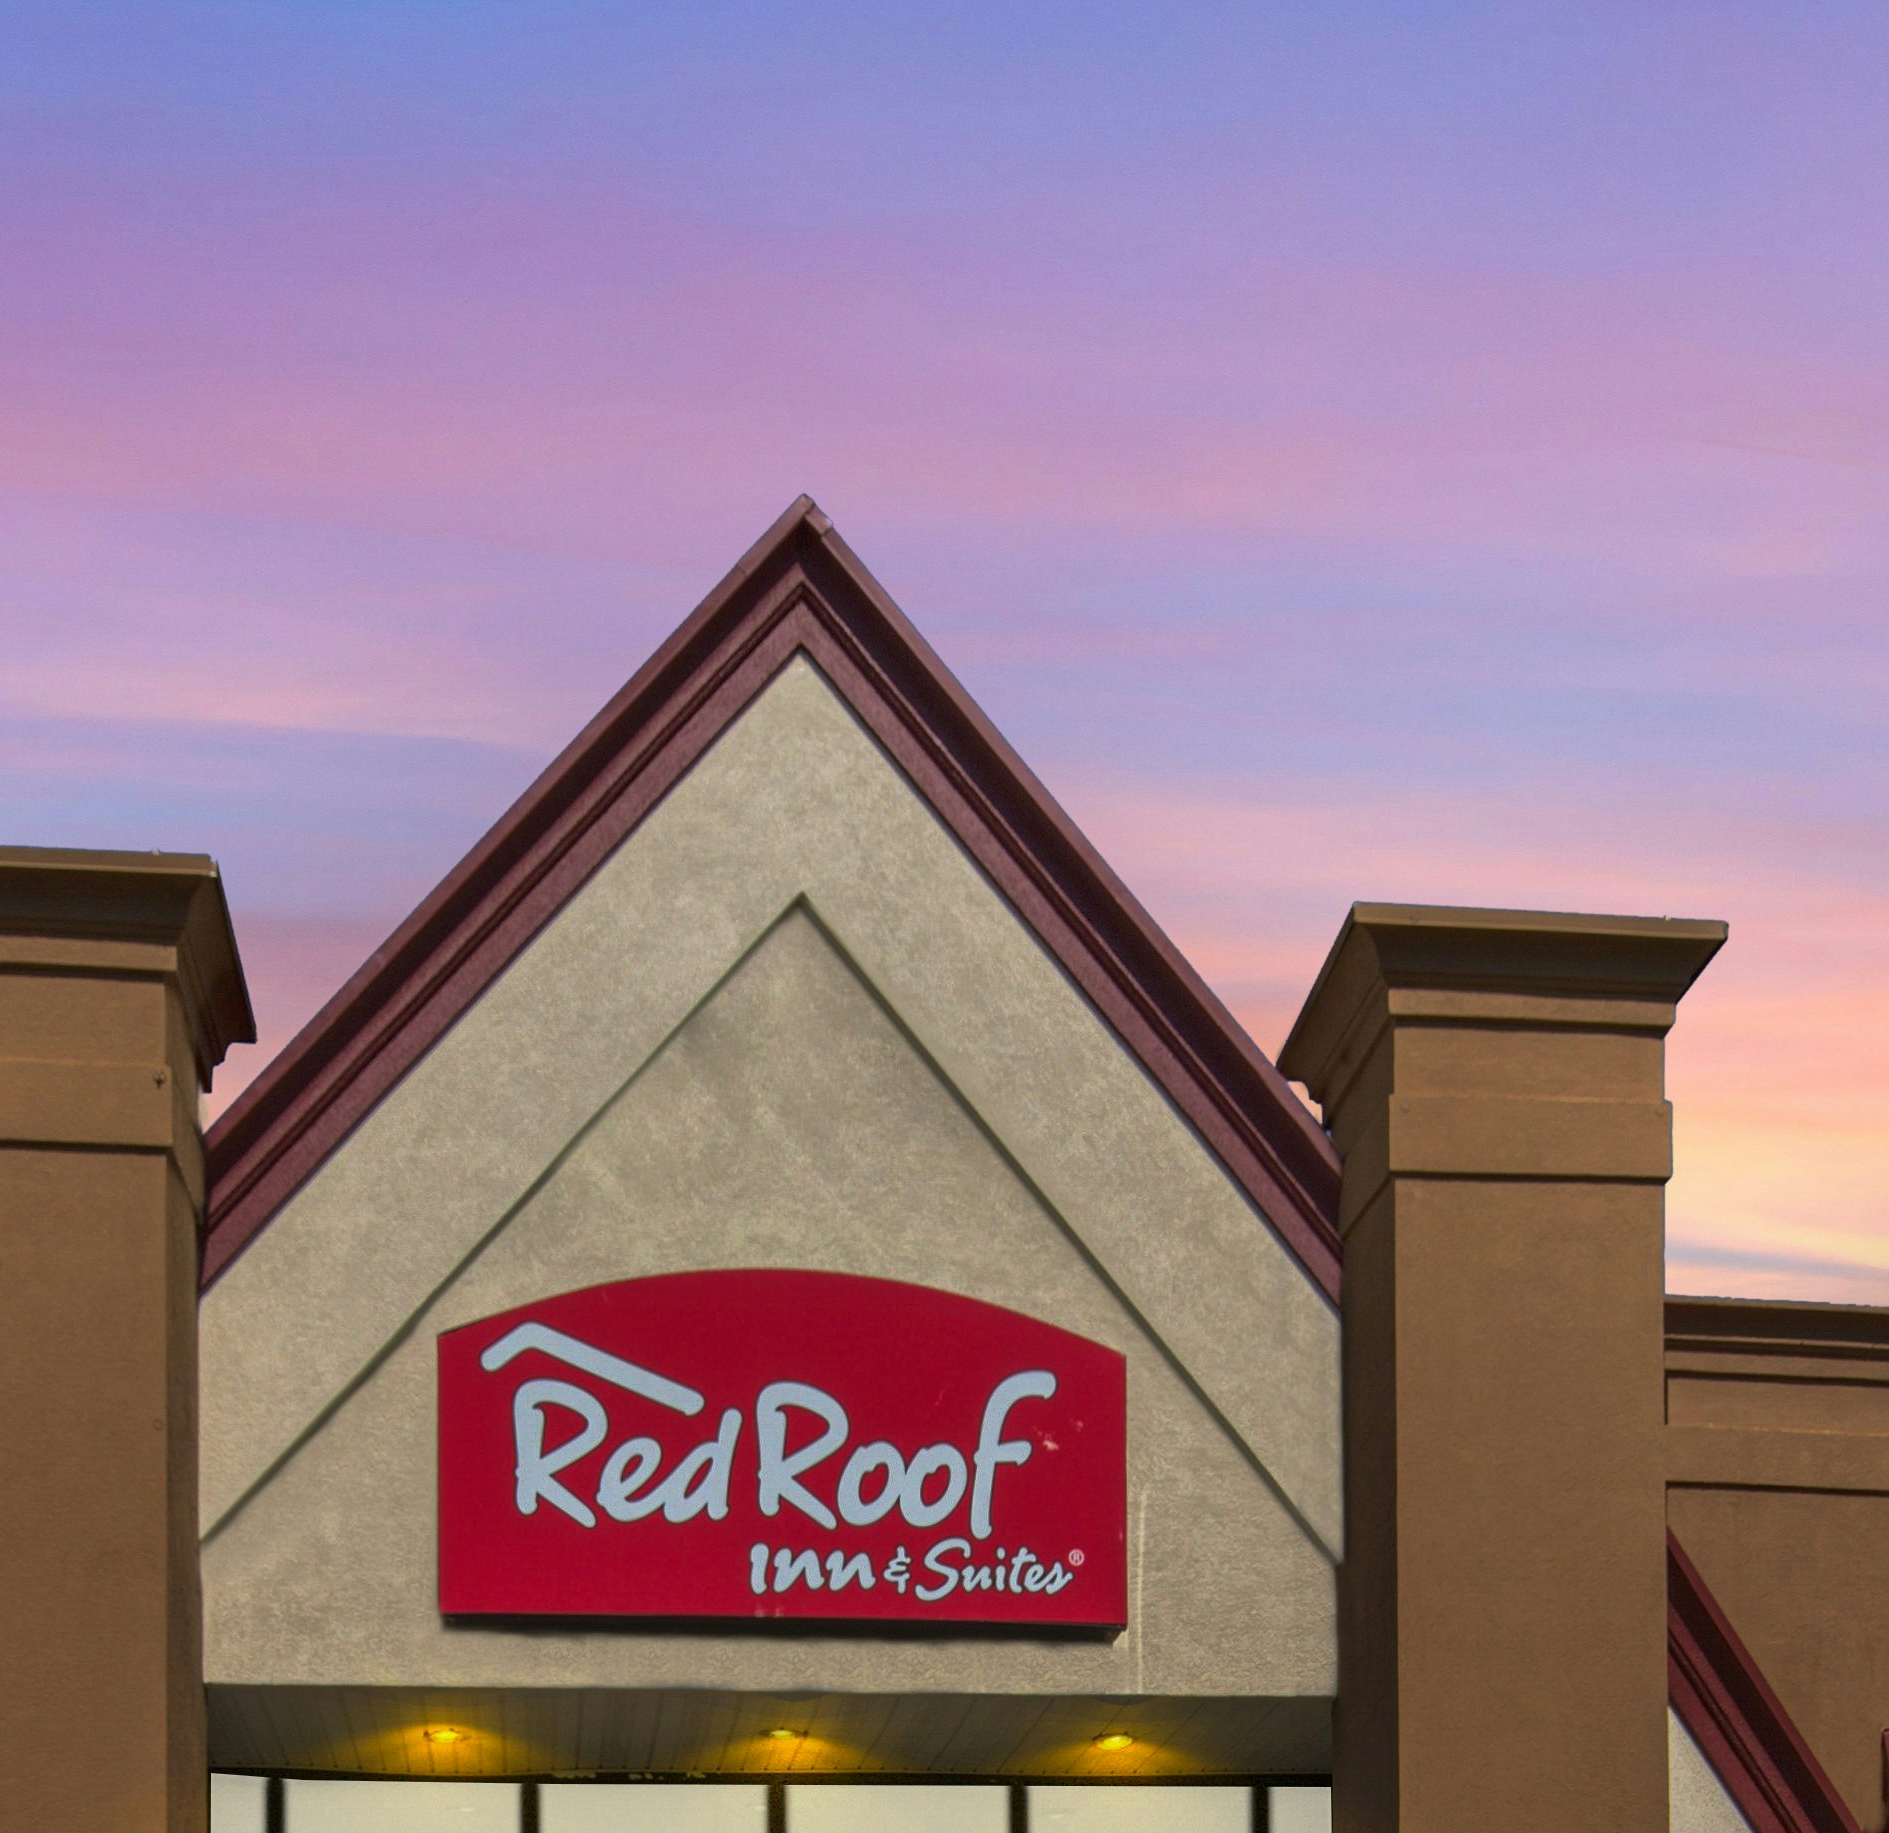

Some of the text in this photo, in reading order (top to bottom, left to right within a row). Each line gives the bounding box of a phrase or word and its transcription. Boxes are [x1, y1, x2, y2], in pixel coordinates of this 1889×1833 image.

[513, 1370, 1057, 1540] Red Roof
[883, 1546, 911, 1594] &
